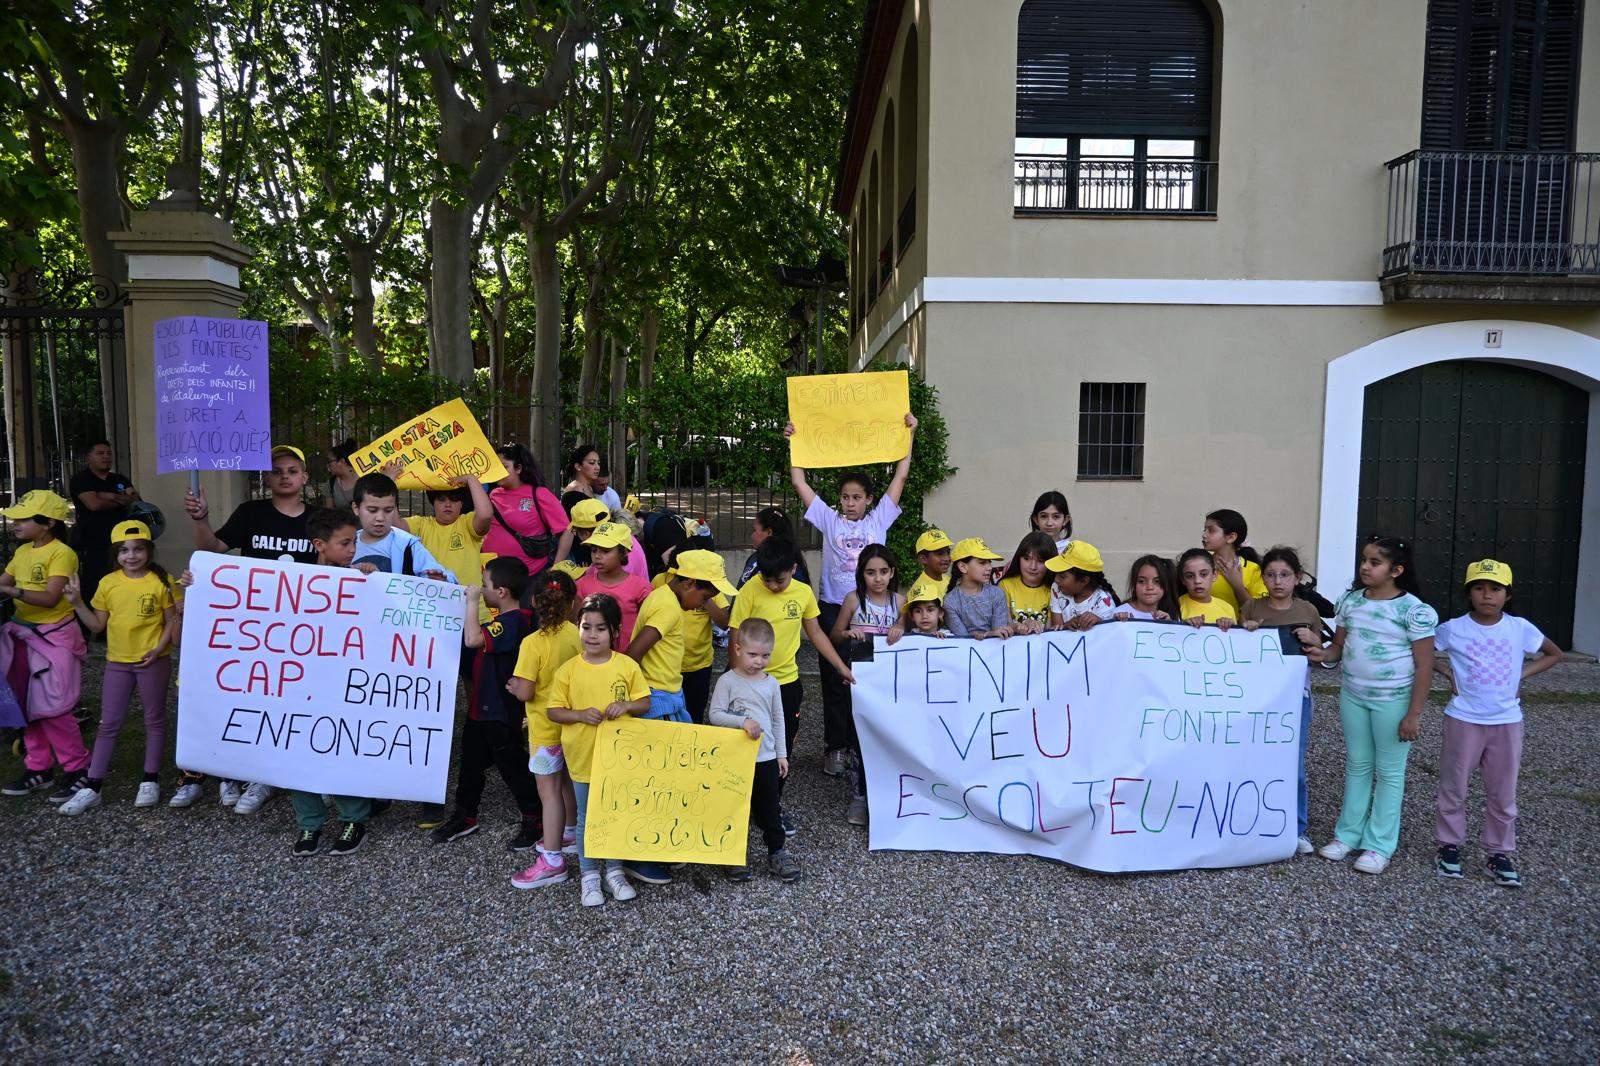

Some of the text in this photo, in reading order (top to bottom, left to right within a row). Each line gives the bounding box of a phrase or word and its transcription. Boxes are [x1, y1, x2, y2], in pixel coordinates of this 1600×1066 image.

[157, 319, 199, 338] ESCOLA
[1487, 332, 1498, 343] 17
[184, 407, 221, 423] DRET
[234, 409, 248, 424] A
[355, 417, 440, 473] LA NOSTRA
[428, 420, 465, 450] ESTA
[210, 455, 242, 470] VEU?
[252, 535, 282, 551] CALL
[209, 564, 367, 615] SENSE
[385, 578, 462, 602] ESCOLA
[407, 598, 436, 612] LES
[380, 608, 462, 632] FONTETES
[208, 618, 435, 669] ESCOLA NI
[1133, 630, 1285, 665] ESCOLA
[874, 635, 1090, 703] TENIM
[1184, 671, 1244, 699] LES
[344, 668, 442, 713] BARRI
[221, 708, 443, 767] ENFONSAT
[938, 704, 1071, 760] VEU
[1139, 708, 1295, 744] FONTETES
[897, 774, 1287, 839] ESCOLTEU-NOS
